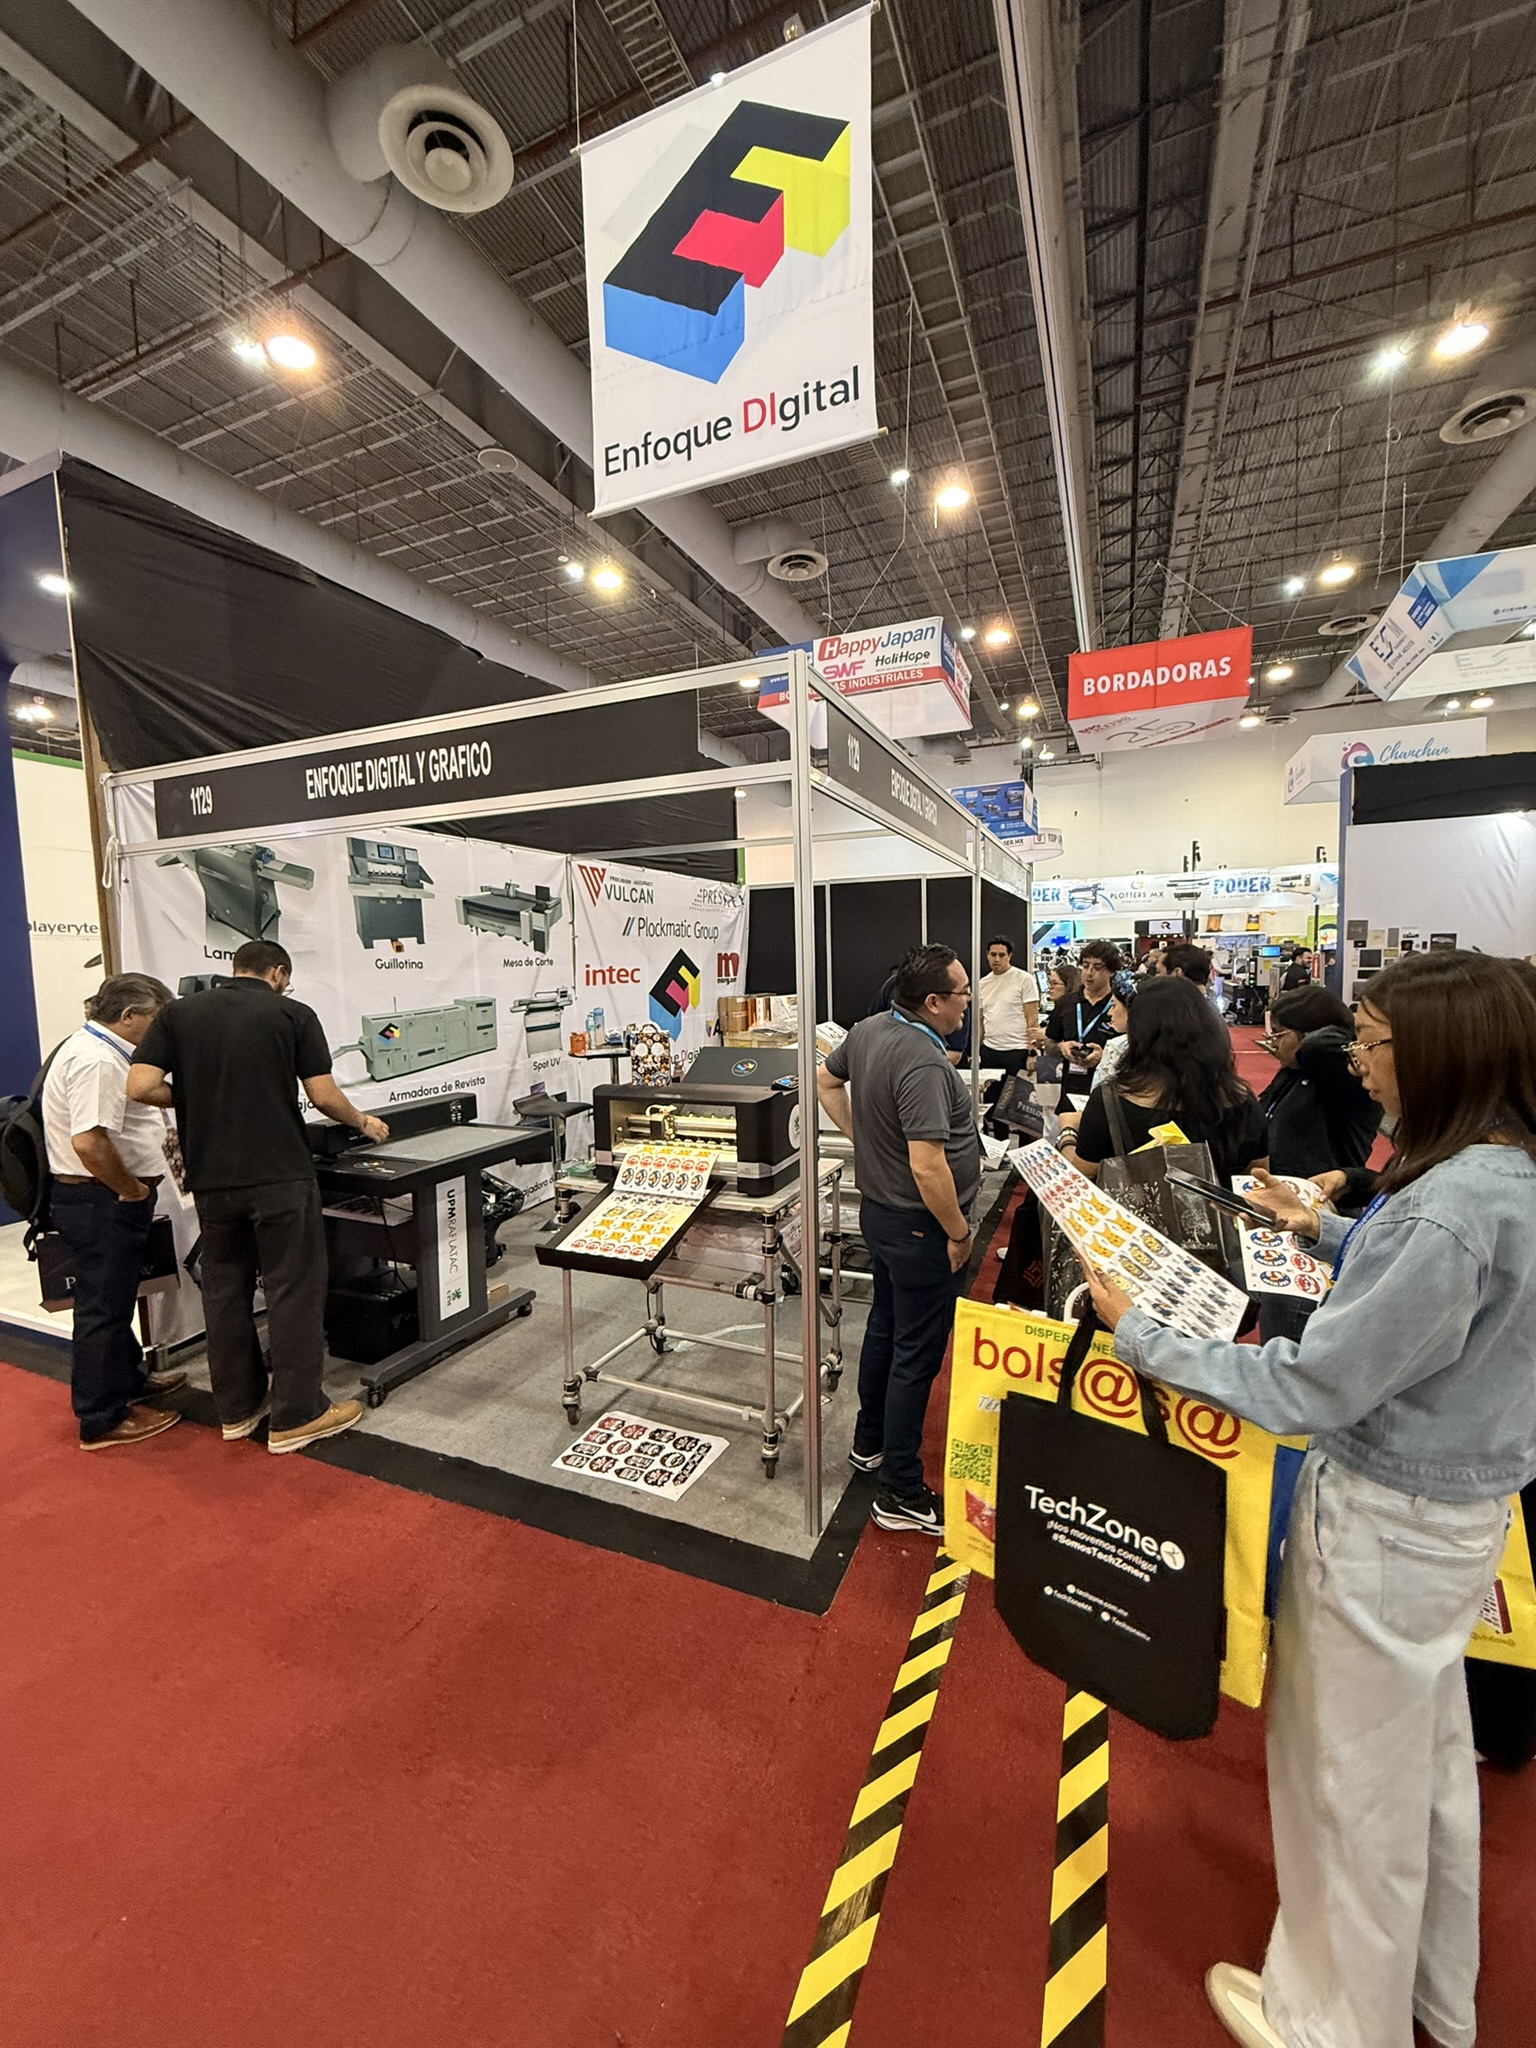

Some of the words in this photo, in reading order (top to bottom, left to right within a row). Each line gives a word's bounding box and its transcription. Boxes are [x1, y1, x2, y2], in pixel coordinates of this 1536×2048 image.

[605, 416, 732, 477] Enfoque
[743, 365, 860, 433] DIgital
[823, 660, 865, 680] SWF
[849, 669, 924, 689] INDUSTRIALES
[1083, 656, 1232, 697] BORDADORAS
[847, 733, 860, 773] 1129
[190, 785, 213, 816] 1129
[305, 760, 363, 800] ENFOQUE
[366, 753, 415, 791] DIGITAL
[415, 751, 426, 785] Y
[429, 741, 492, 783] GRAFICO
[605, 884, 654, 904] VULCAN
[1110, 891, 1147, 899] PLOTTERS
[1213, 876, 1272, 895] PODER
[638, 916, 691, 938] Plockmatic
[694, 921, 719, 943] Group
[375, 958, 424, 970] Guillotina
[503, 958, 523, 968] Mesa
[524, 957, 534, 966] de
[535, 957, 554, 967] Corte
[585, 964, 640, 986] intec
[533, 1060, 549, 1072] Spot
[550, 1057, 561, 1068] UV
[389, 1085, 439, 1102] Armadora
[440, 1082, 453, 1093] de
[455, 1076, 485, 1090] Revista
[1070, 1527, 1117, 1553] movemos
[1052, 1532, 1150, 1583] #SomosTechZoners
